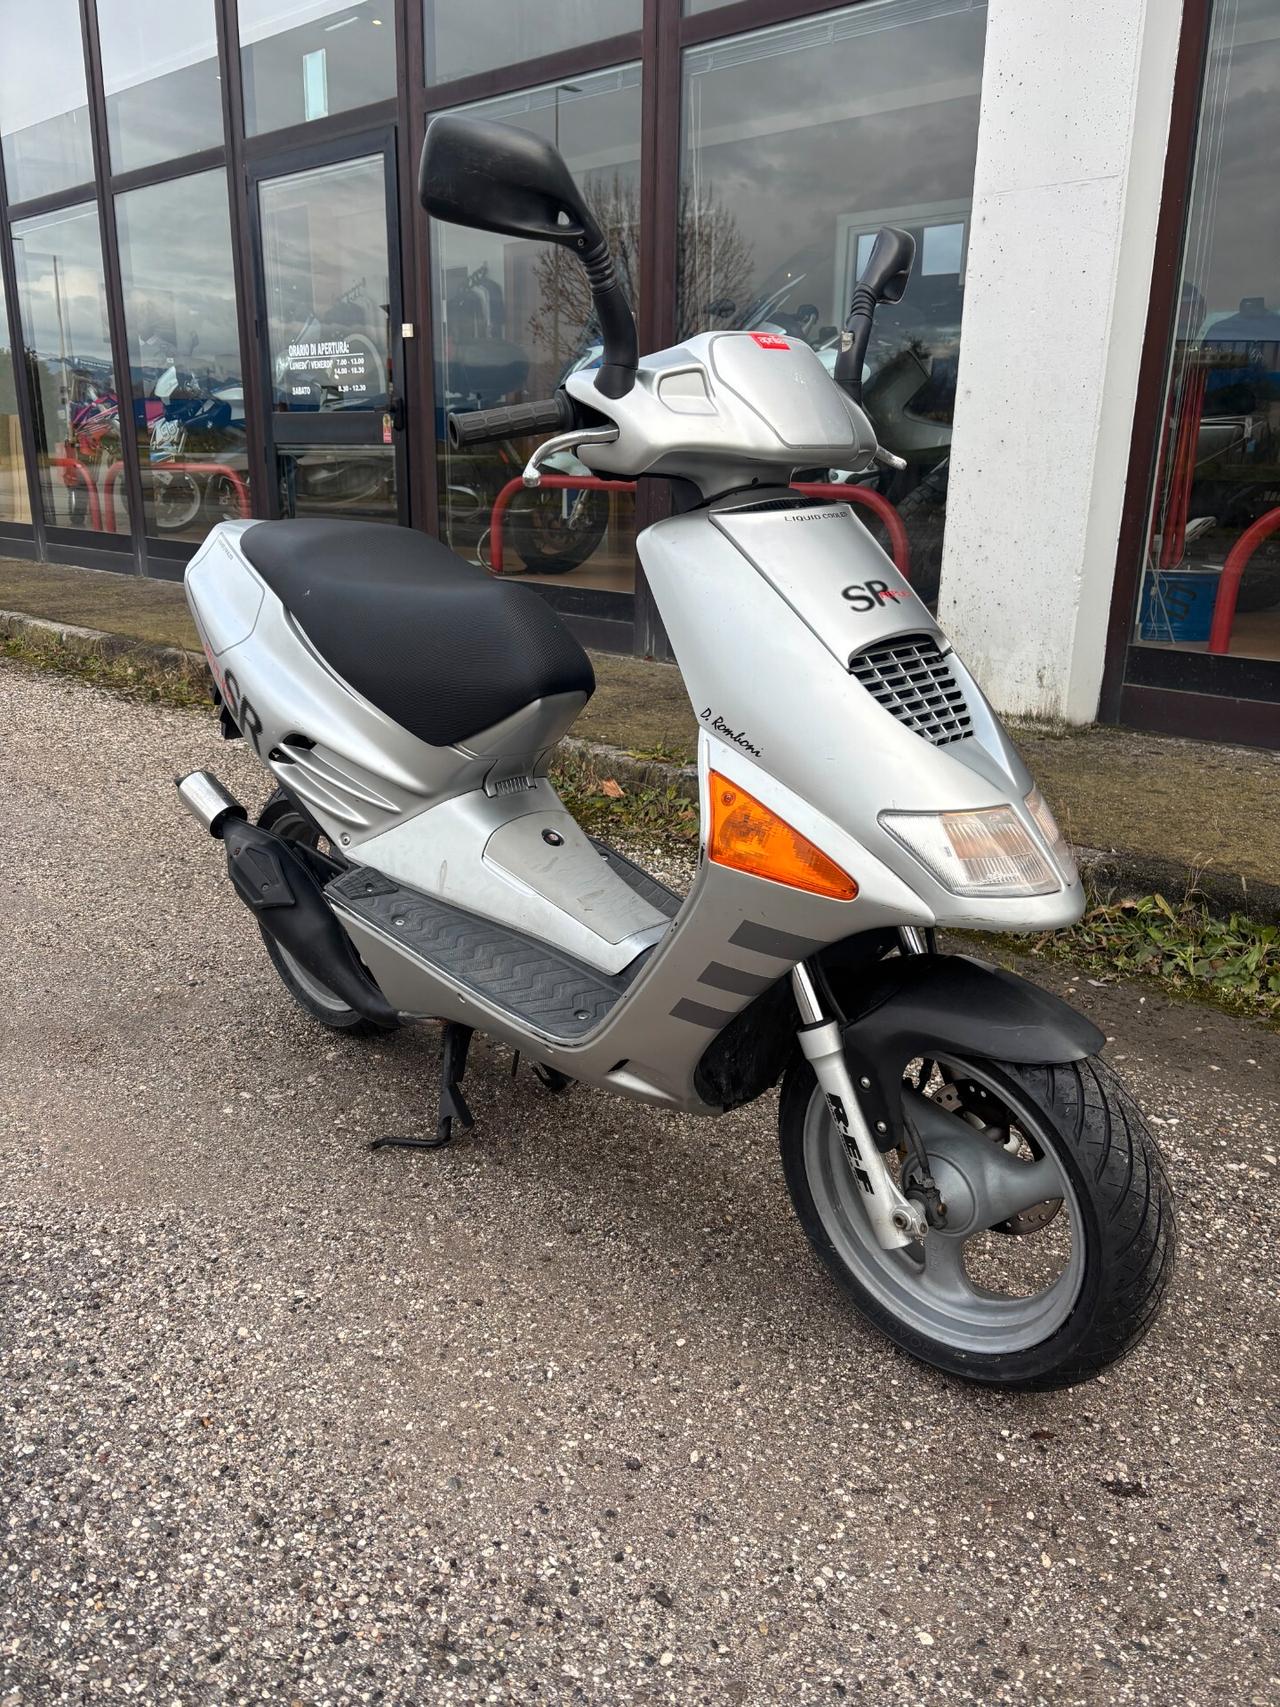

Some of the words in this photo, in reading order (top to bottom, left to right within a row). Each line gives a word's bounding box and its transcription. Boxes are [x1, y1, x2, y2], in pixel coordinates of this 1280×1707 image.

[289, 344, 309, 356] ORARIO
[310, 343, 317, 355] DI
[317, 341, 350, 354] APERTURA:
[336, 358, 347, 366] 7.00
[291, 386, 311, 395] SABATO
[784, 514, 821, 522] LIQUID
[841, 580, 901, 612] SR
[222, 668, 263, 758] SR
[700, 707, 712, 721] D.
[711, 716, 764, 758] Romboni
